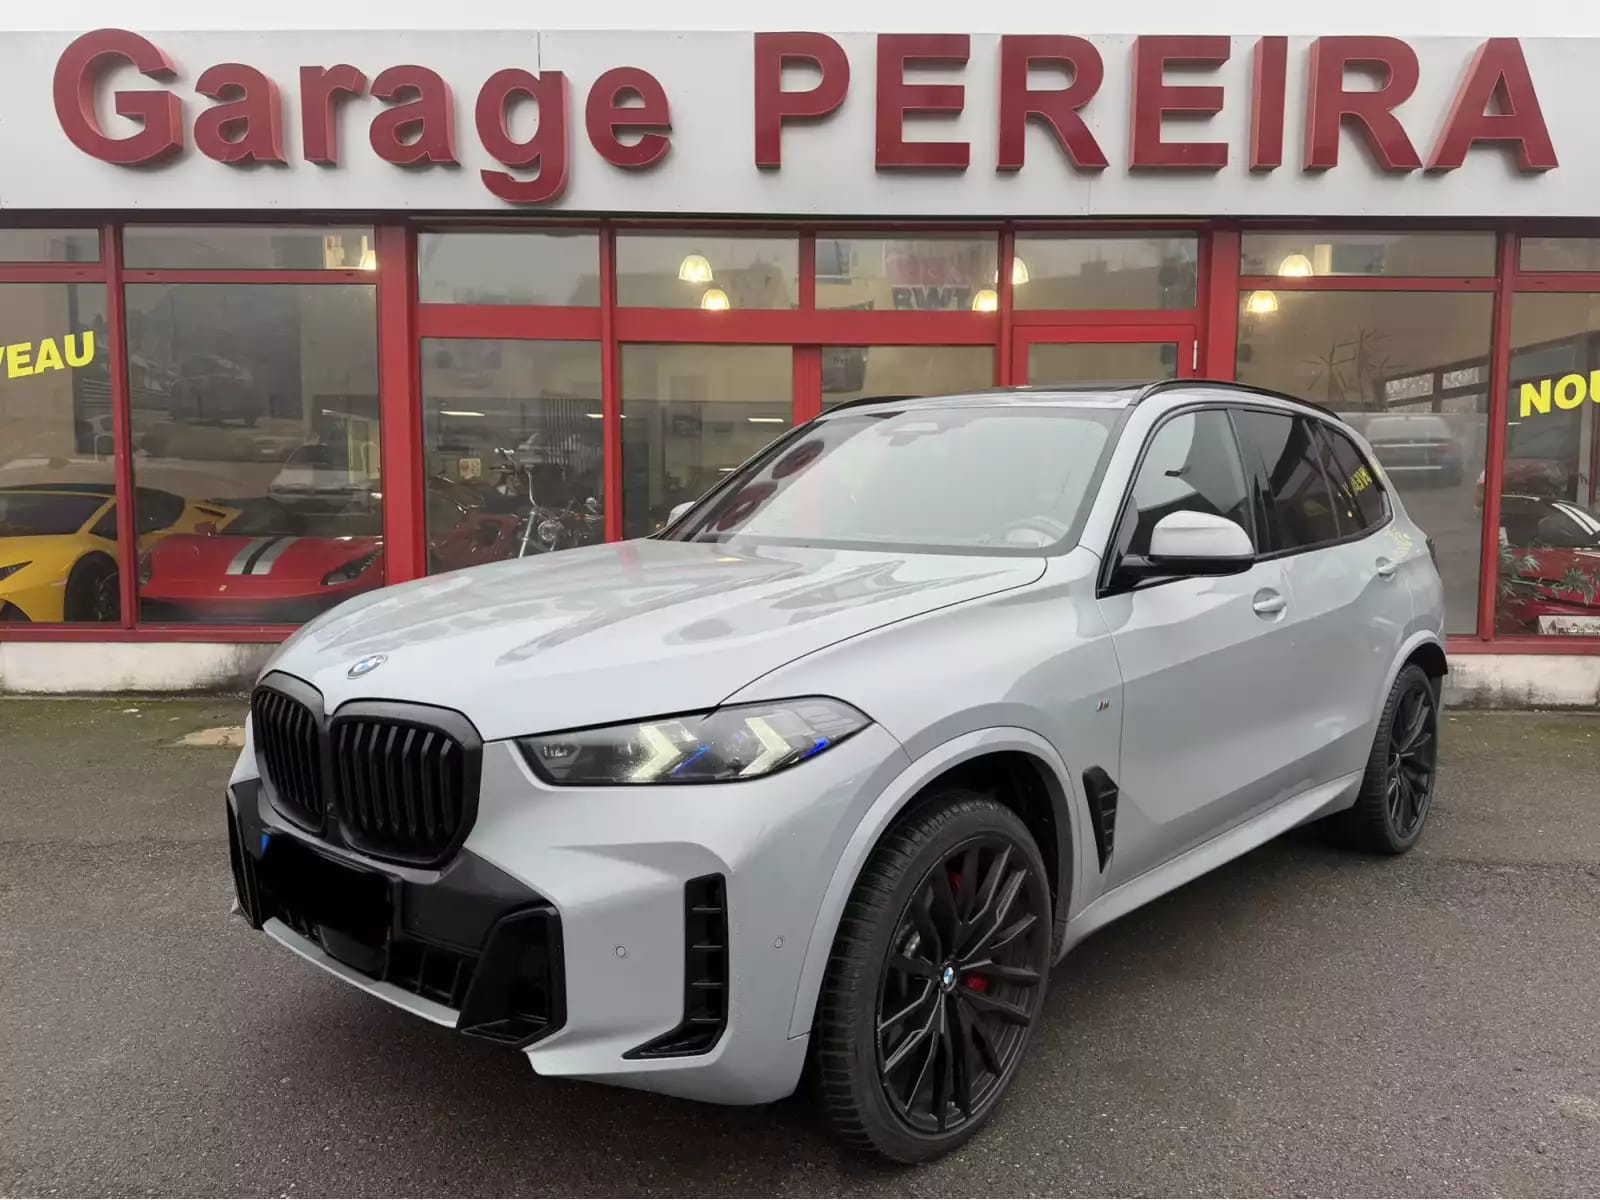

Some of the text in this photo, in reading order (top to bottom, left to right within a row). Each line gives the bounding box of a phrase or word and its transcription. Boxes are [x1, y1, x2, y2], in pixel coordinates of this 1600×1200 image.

[53, 28, 1559, 202] Garage PEREIRA
[0, 331, 95, 378] EAU
